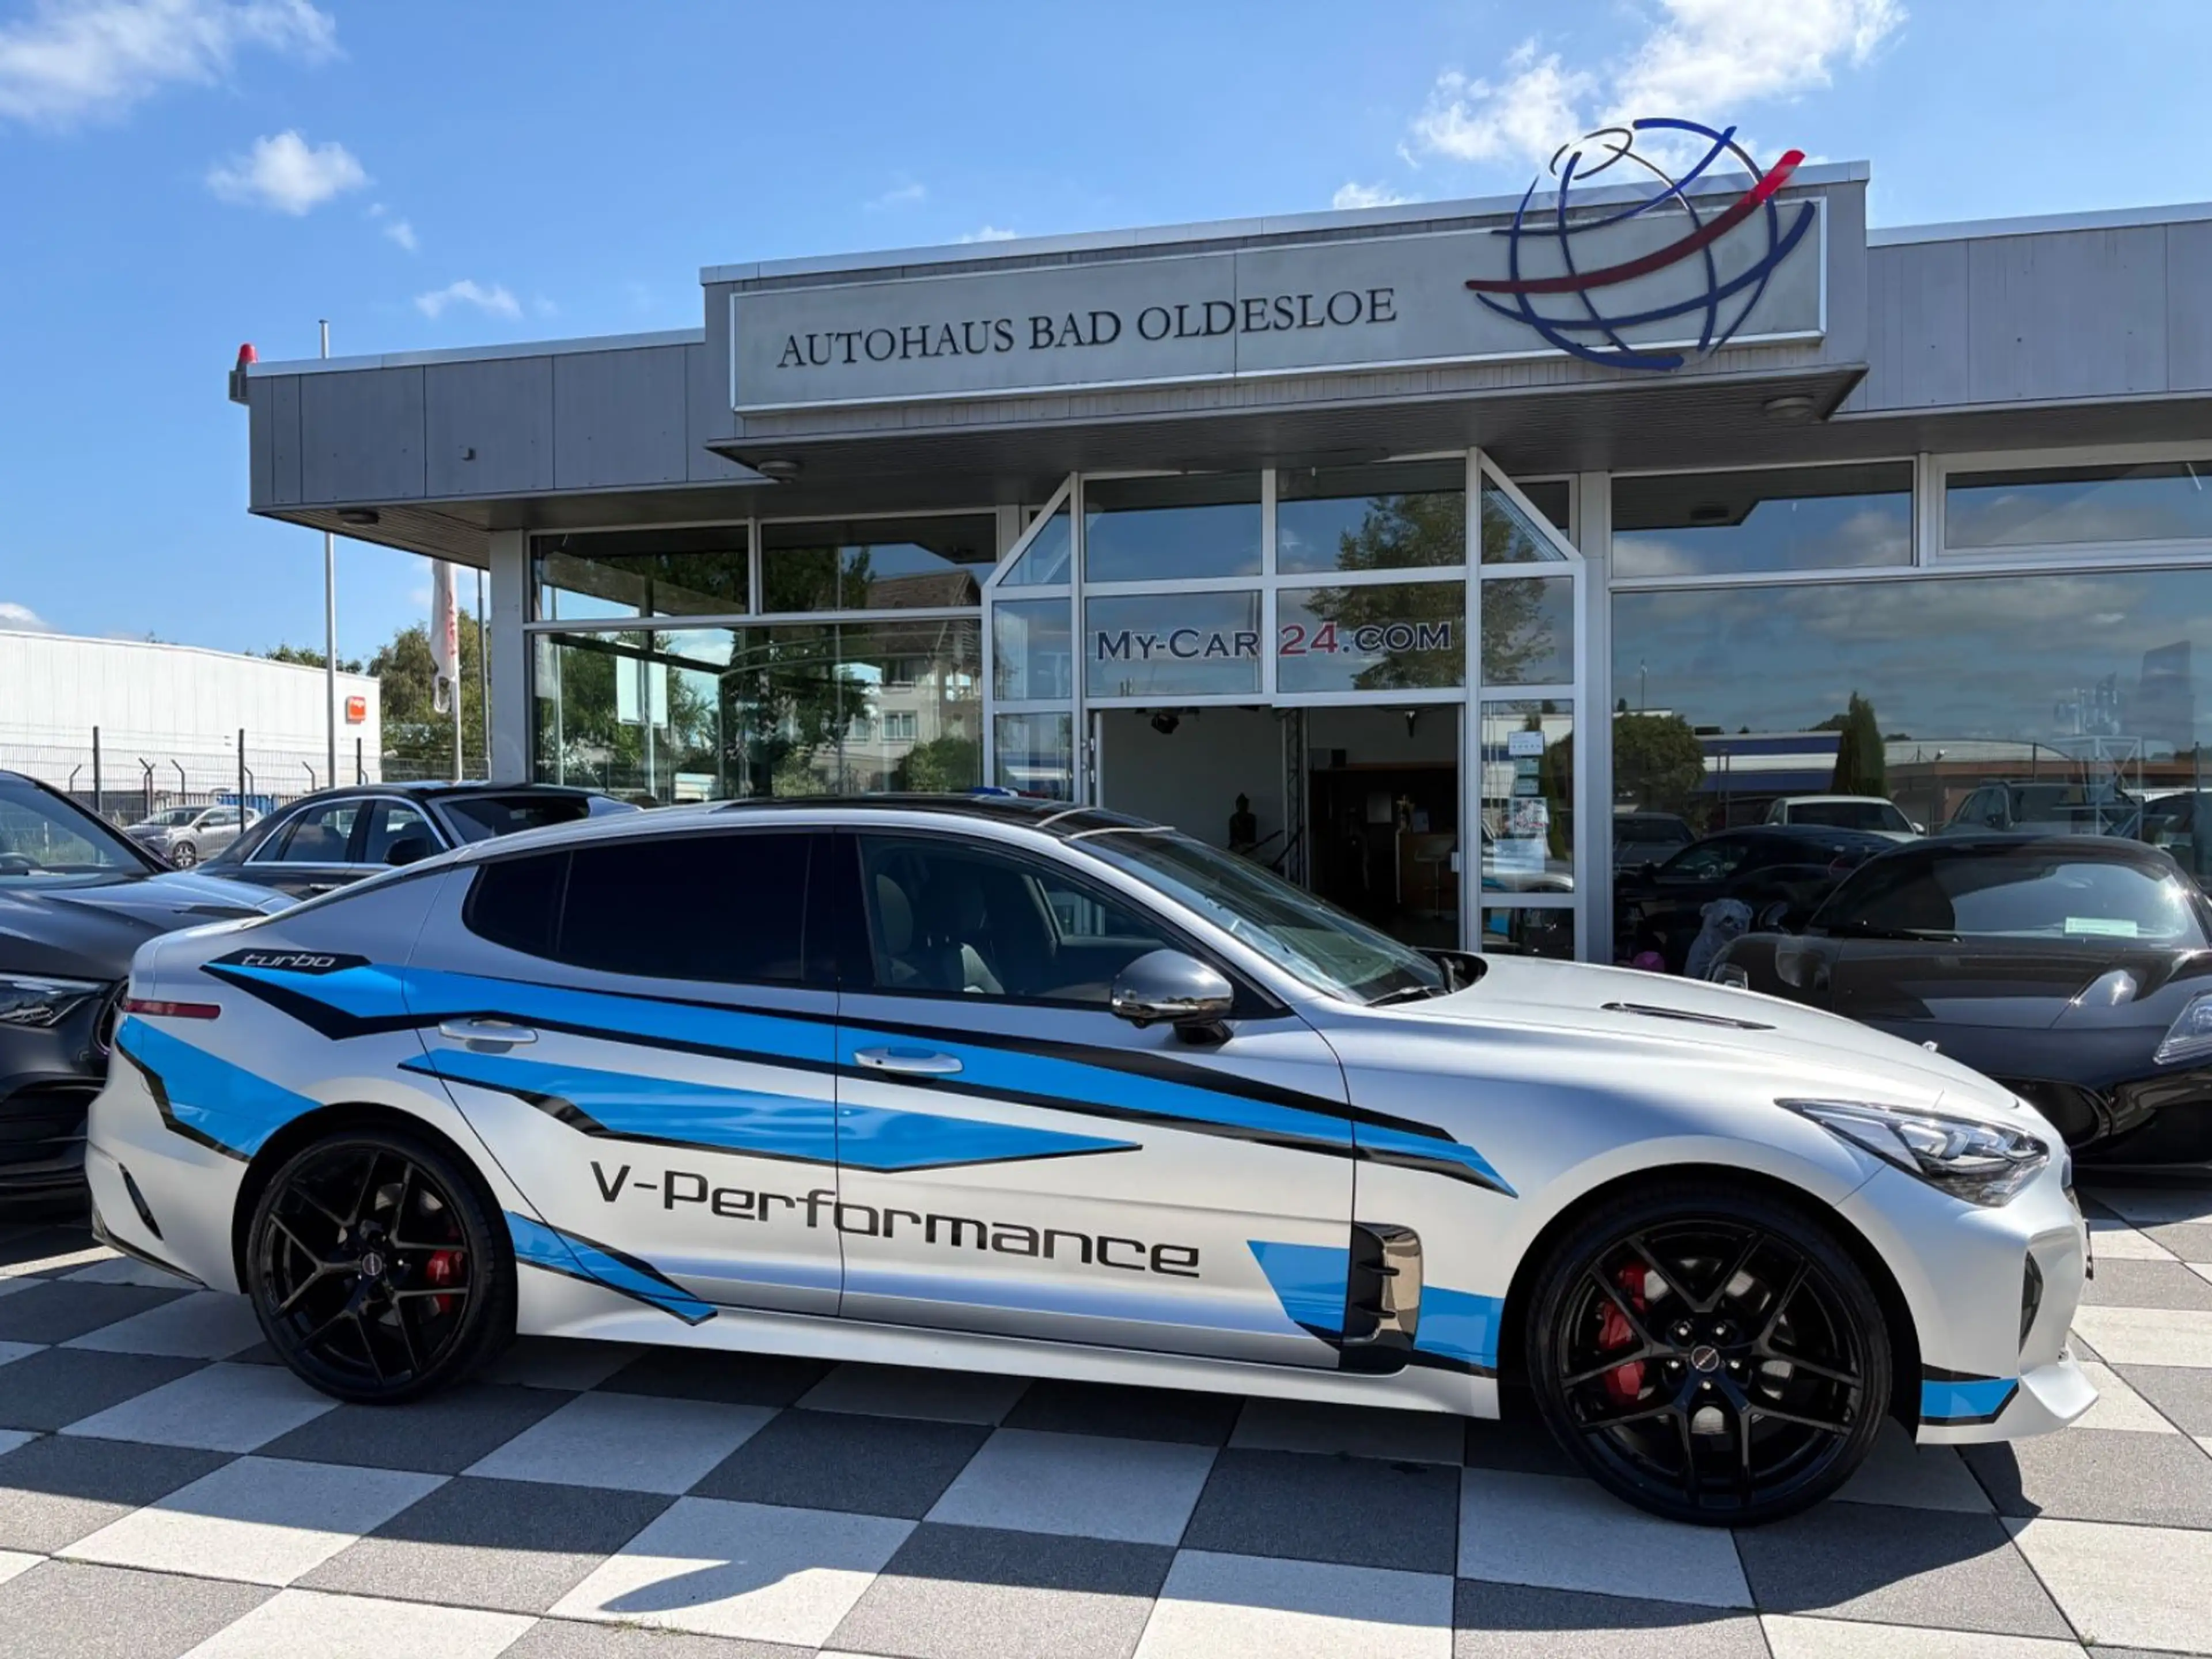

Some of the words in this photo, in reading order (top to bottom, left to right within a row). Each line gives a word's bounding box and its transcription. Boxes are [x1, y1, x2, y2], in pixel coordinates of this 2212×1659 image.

[777, 317, 1015, 369] AUTOHAUS
[1028, 309, 1123, 350] BAD
[1136, 288, 1399, 342] OLDESLOE
[241, 953, 336, 967] turbo
[590, 1161, 1200, 1278] V-Performance
